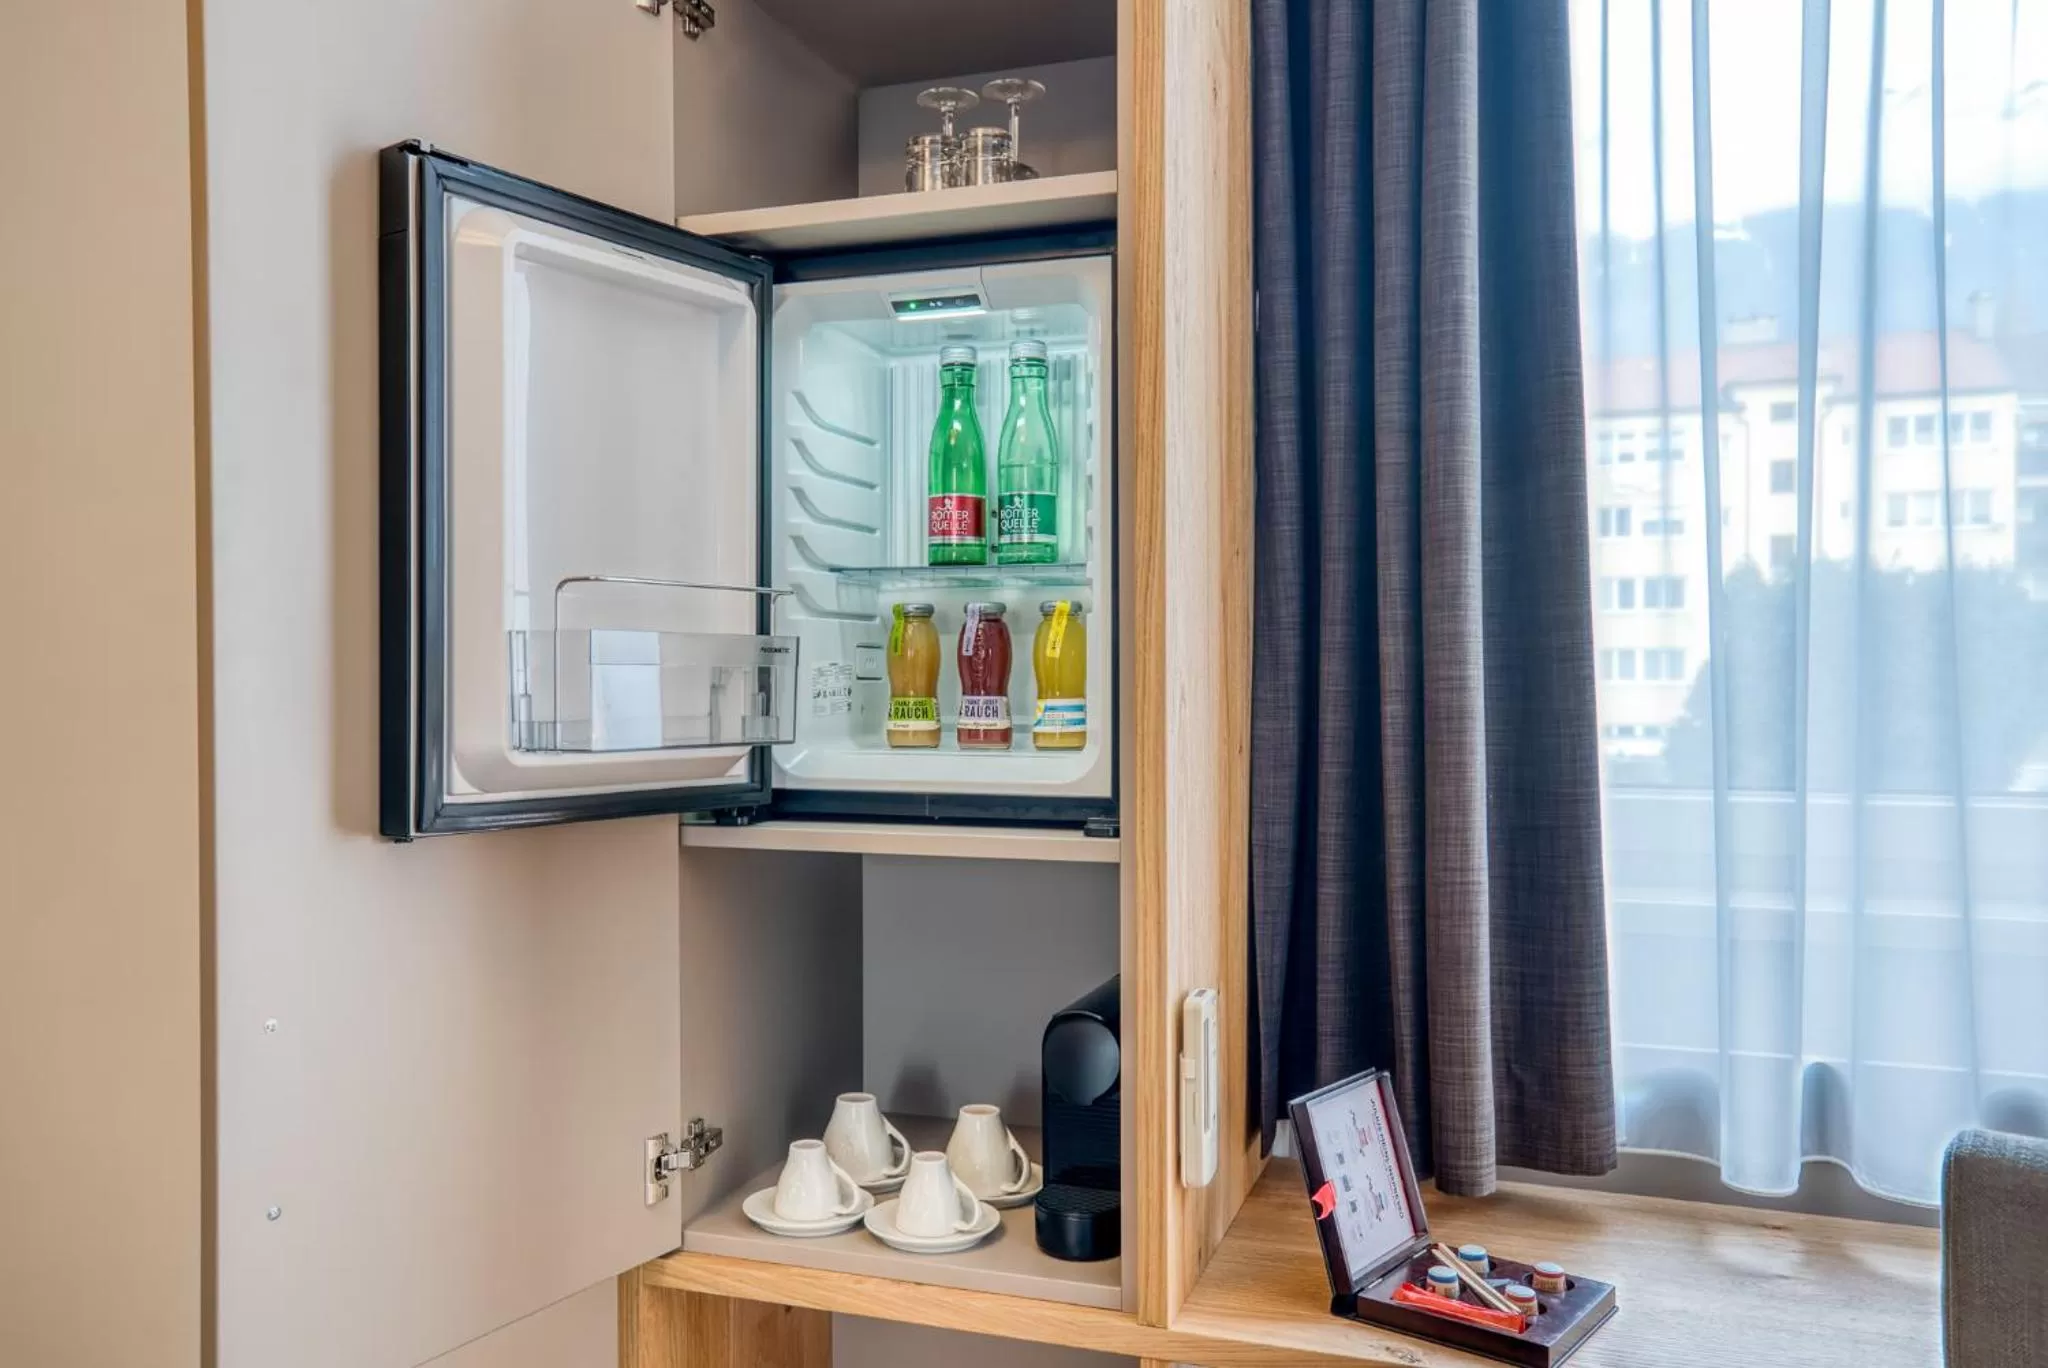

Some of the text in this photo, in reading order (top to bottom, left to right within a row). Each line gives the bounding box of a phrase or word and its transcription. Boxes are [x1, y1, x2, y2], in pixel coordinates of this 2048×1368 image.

[931, 520, 969, 533] QUELLE
[1000, 518, 1039, 532] QUELLE
[894, 706, 928, 719] RAUCH
[965, 705, 999, 718] RAUCH
